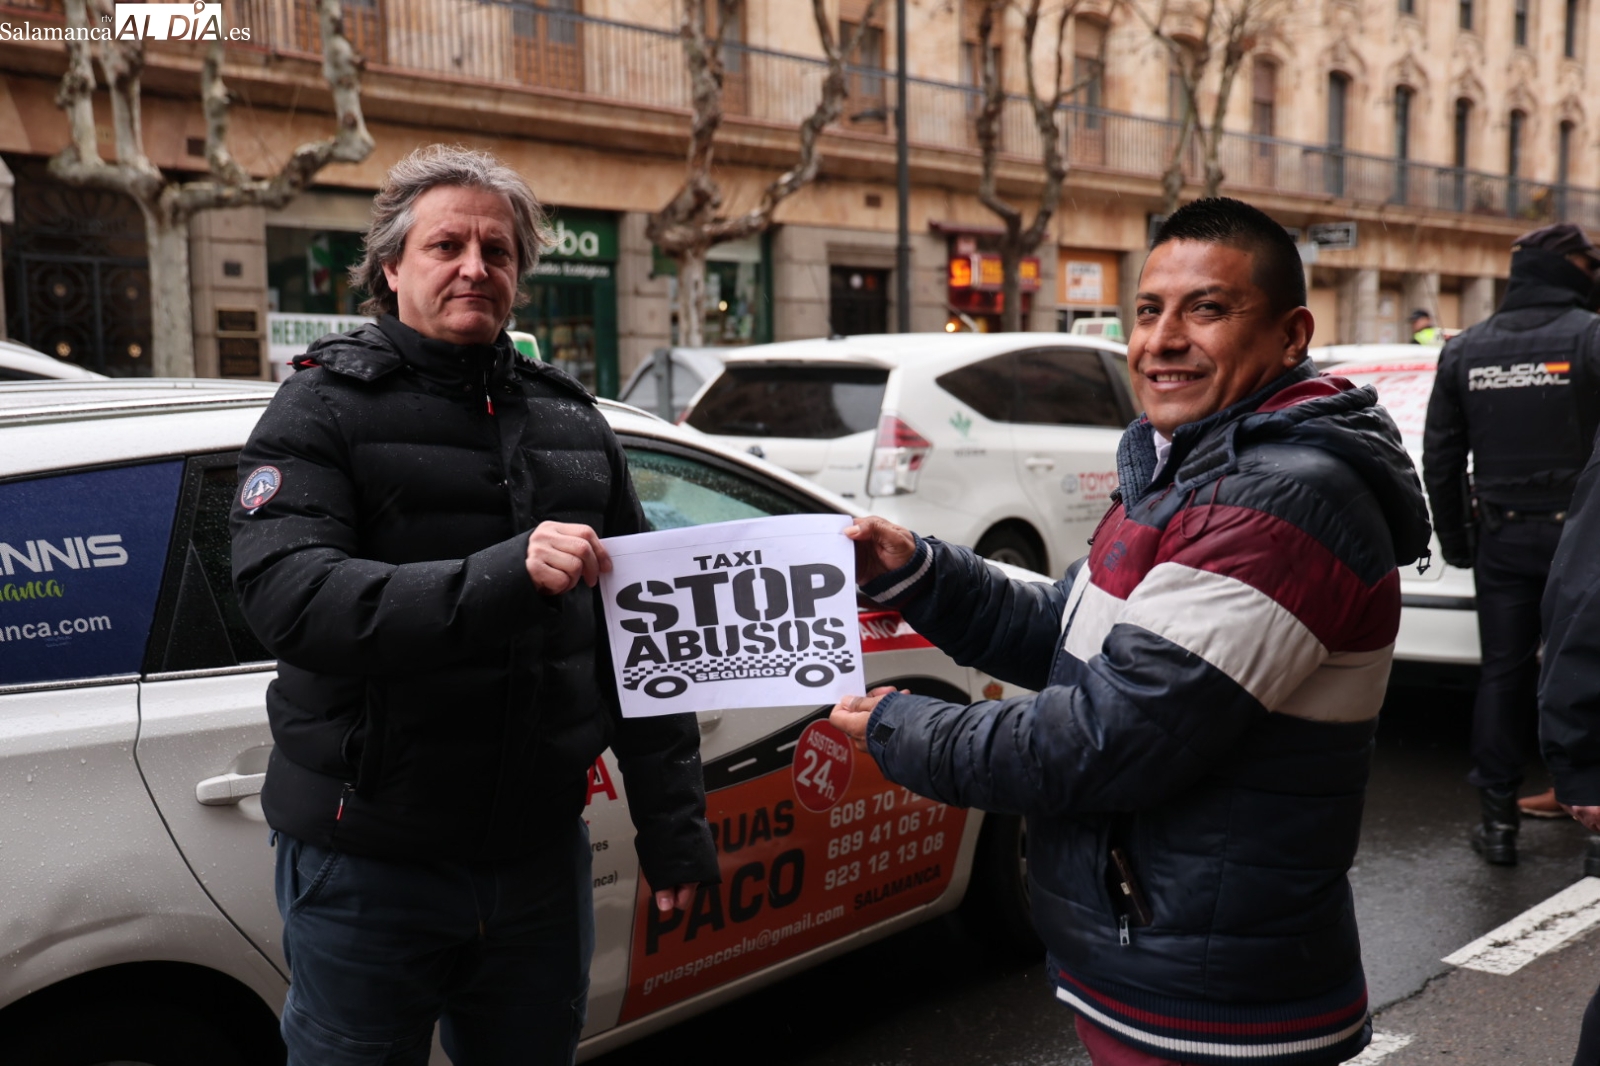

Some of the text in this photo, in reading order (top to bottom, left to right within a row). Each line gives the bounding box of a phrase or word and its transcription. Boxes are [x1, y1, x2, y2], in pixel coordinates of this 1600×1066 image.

[1469, 374, 1570, 391] NACIONAL
[1079, 471, 1119, 491] TOYO
[0, 534, 129, 576] NNIS
[693, 549, 763, 571] TAXI
[0, 579, 65, 602] anca
[616, 563, 846, 634] STOP
[624, 617, 847, 668] ABUSOS
[695, 667, 787, 682] SEGUROS
[807, 728, 849, 764] ASISTENCIA
[709, 799, 795, 854] UAS
[827, 803, 948, 859] 689 41 06 77
[830, 799, 866, 829] 608
[872, 790, 895, 815] 70
[824, 831, 945, 891] 923 12 13 08
[645, 847, 805, 957] PACO
[854, 864, 942, 911] SALAMANCA
[642, 904, 845, 996] gruaspacoslu@gmail.com
